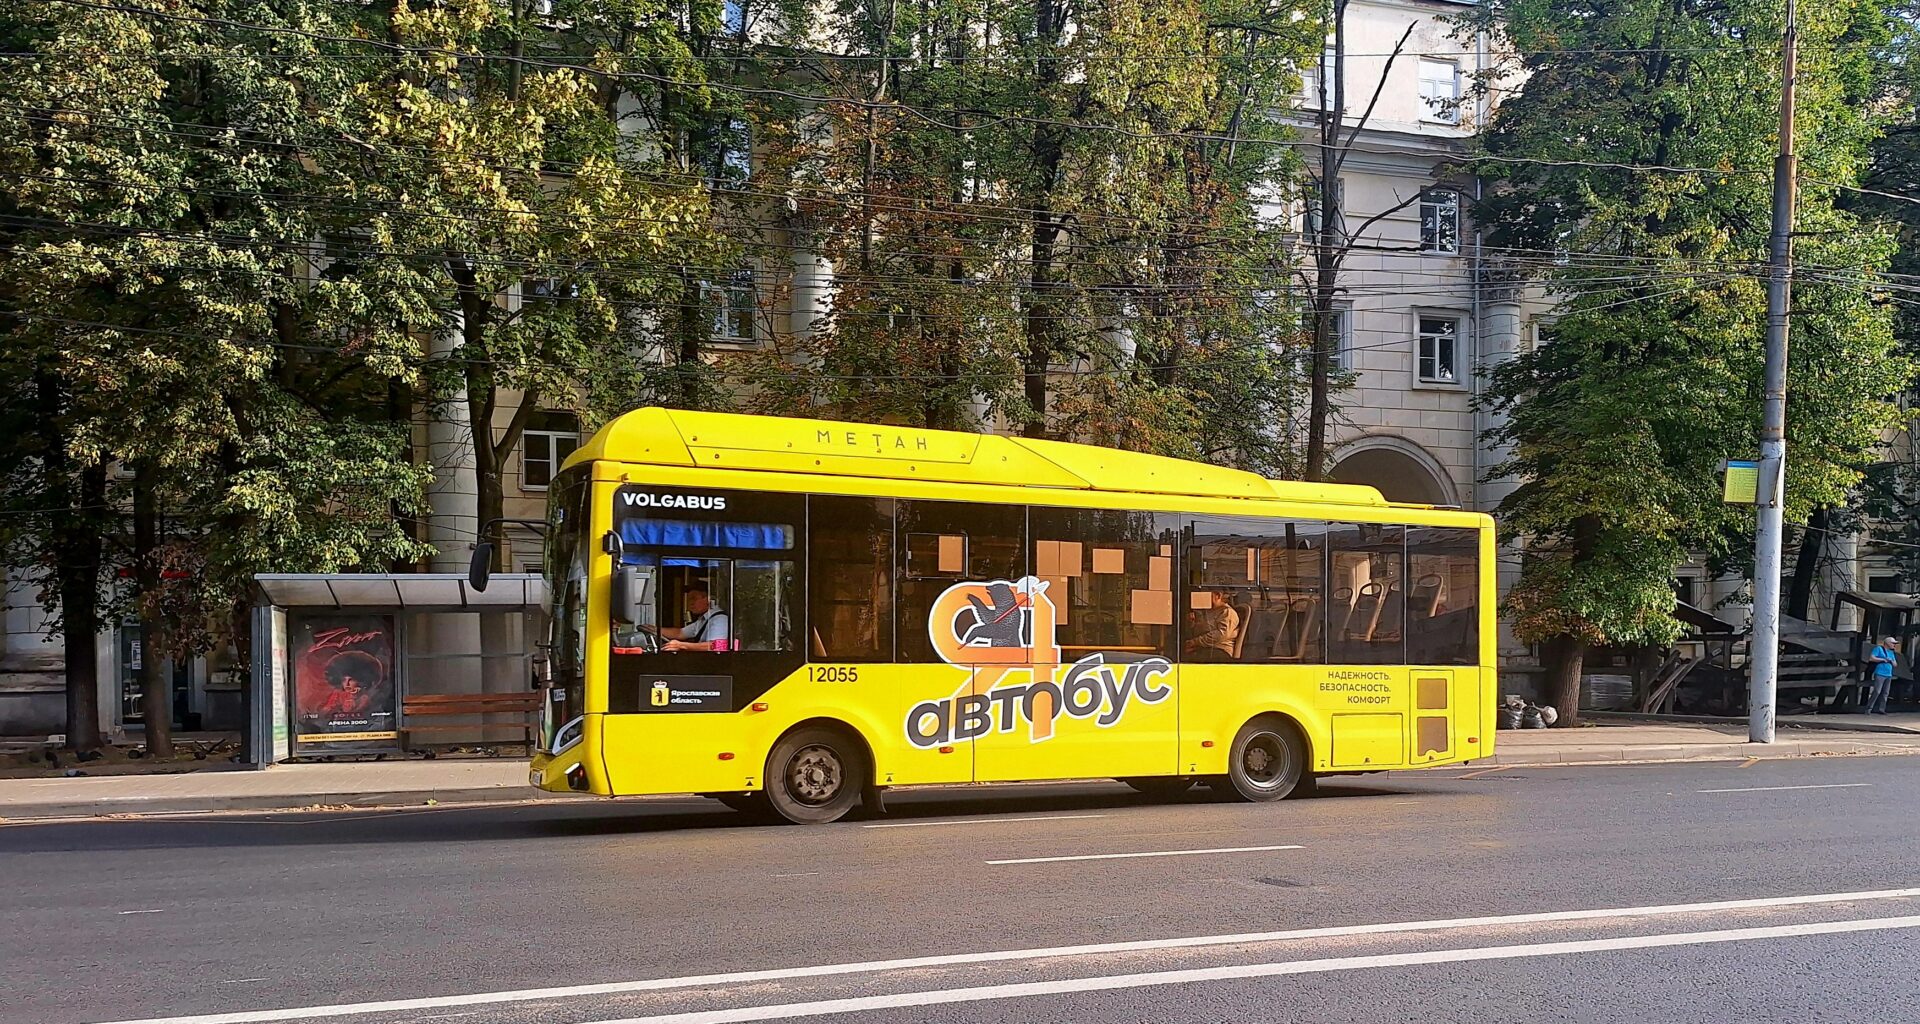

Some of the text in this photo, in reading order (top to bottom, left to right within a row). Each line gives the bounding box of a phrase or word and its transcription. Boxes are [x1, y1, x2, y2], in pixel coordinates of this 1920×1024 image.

[816, 429, 928, 451] МЕТАН
[622, 492, 726, 510] VOLGABUS
[807, 666, 858, 683] 12055
[1327, 671, 1392, 681] НАДЕЖНОСТЬ.
[1319, 683, 1392, 693] БЕЗОПАСНОСТЬ.
[906, 654, 1172, 746] автобус
[1347, 695, 1391, 705] КОМФОРТ
